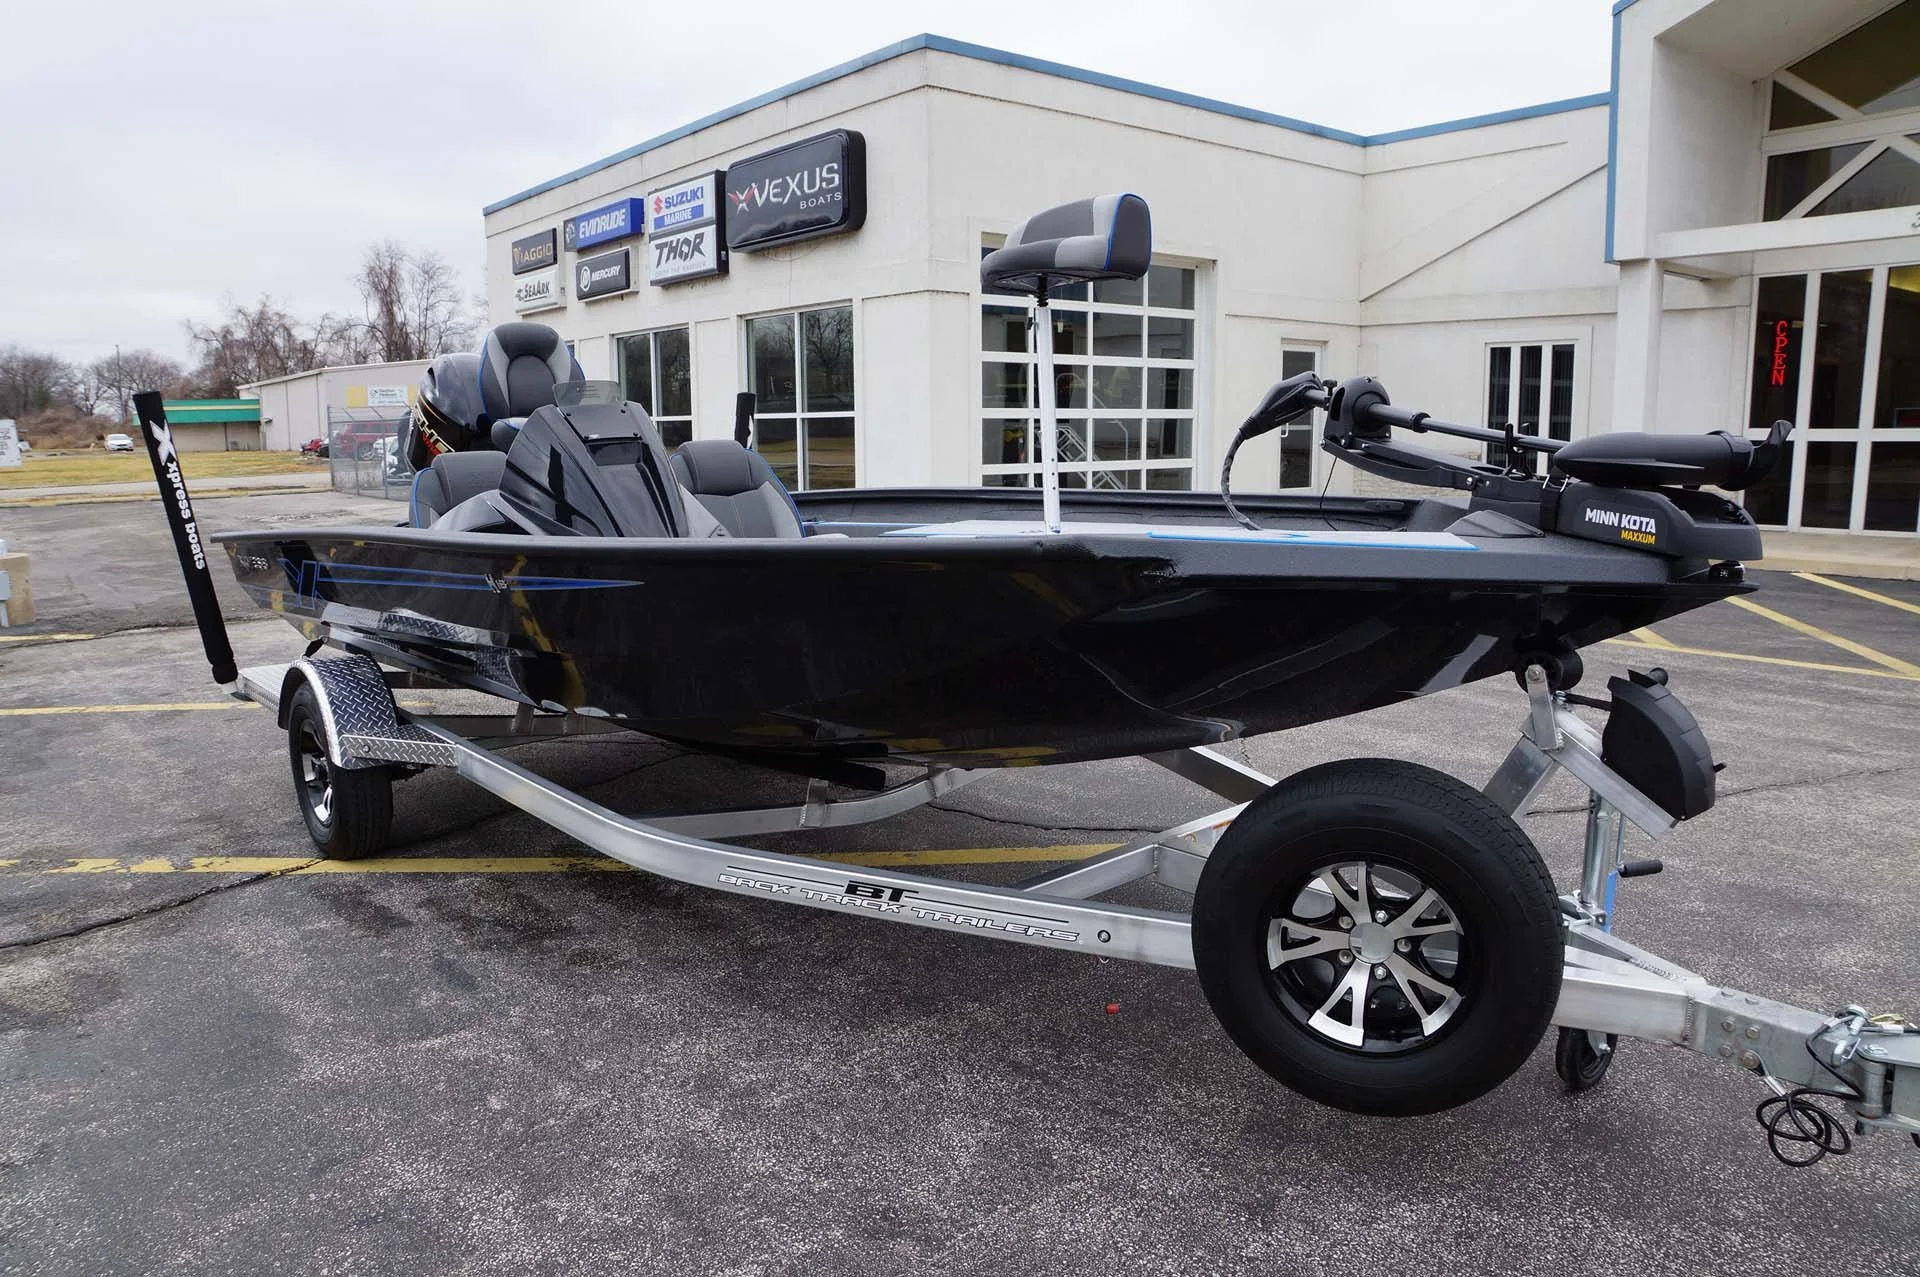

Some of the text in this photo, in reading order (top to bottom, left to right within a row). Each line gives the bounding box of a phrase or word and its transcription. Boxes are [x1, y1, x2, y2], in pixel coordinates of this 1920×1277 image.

[664, 186, 704, 209] SUZUKI
[750, 162, 841, 208] VEXUS
[799, 191, 842, 210] BOATS
[579, 208, 627, 239] EVINRUDE
[664, 208, 693, 226] MARINE
[654, 232, 706, 269] THOR
[591, 265, 622, 281] MERCURY
[1585, 508, 1656, 533] MINN KOTA
[184, 521, 206, 571] boats
[1620, 530, 1655, 544] MAXXUM
[718, 872, 1080, 942] BACK TRACK TRAILERS
